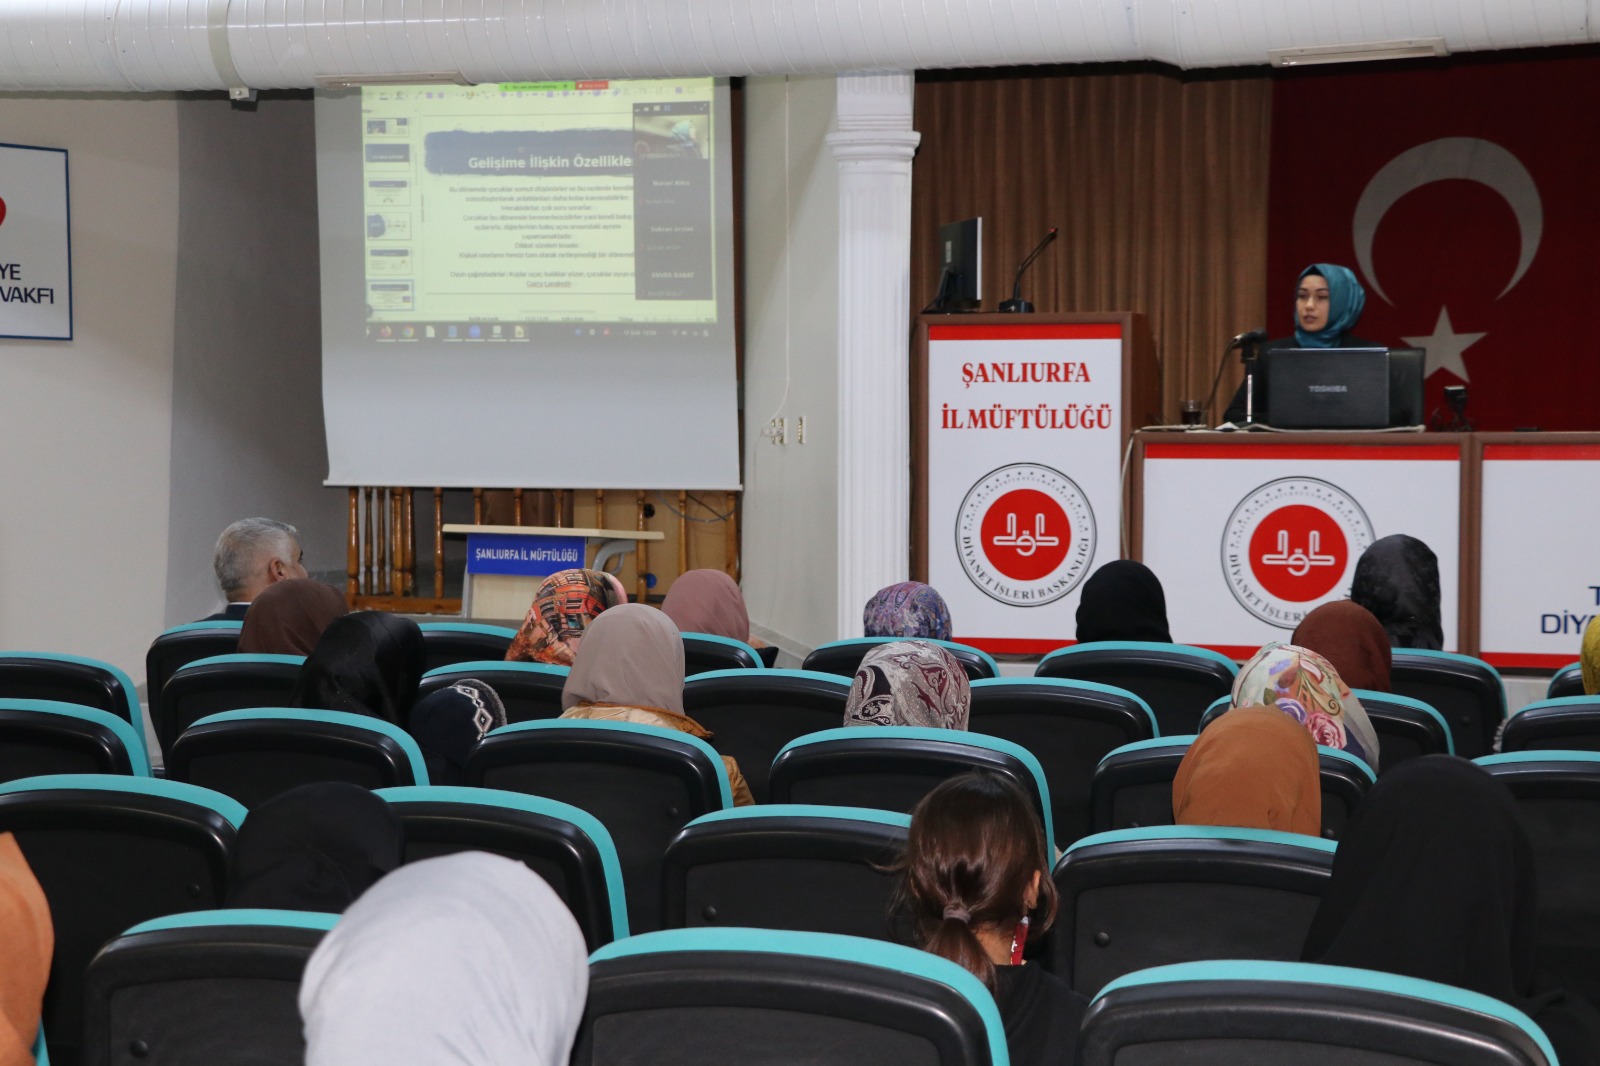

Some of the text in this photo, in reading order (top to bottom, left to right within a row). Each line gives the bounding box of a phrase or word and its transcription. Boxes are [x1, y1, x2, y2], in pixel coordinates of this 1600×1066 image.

[468, 156, 526, 171] Gelişime
[529, 154, 569, 171] İlişkin
[573, 153, 633, 168] Özellikle
[0, 286, 54, 304] VAKFI
[962, 362, 1091, 389] ŞANLIURFA
[941, 403, 1112, 429] İL MÜFTÜLÜĞÜ
[476, 547, 578, 562] ŞANLIURFA İL MÜFTÜLÜĞÜ
[963, 536, 1089, 599] DİYANET İŞLERİ BAŞKANLIĞI
[1229, 554, 1262, 608] DİYANET
[1541, 609, 1597, 634] DİY
